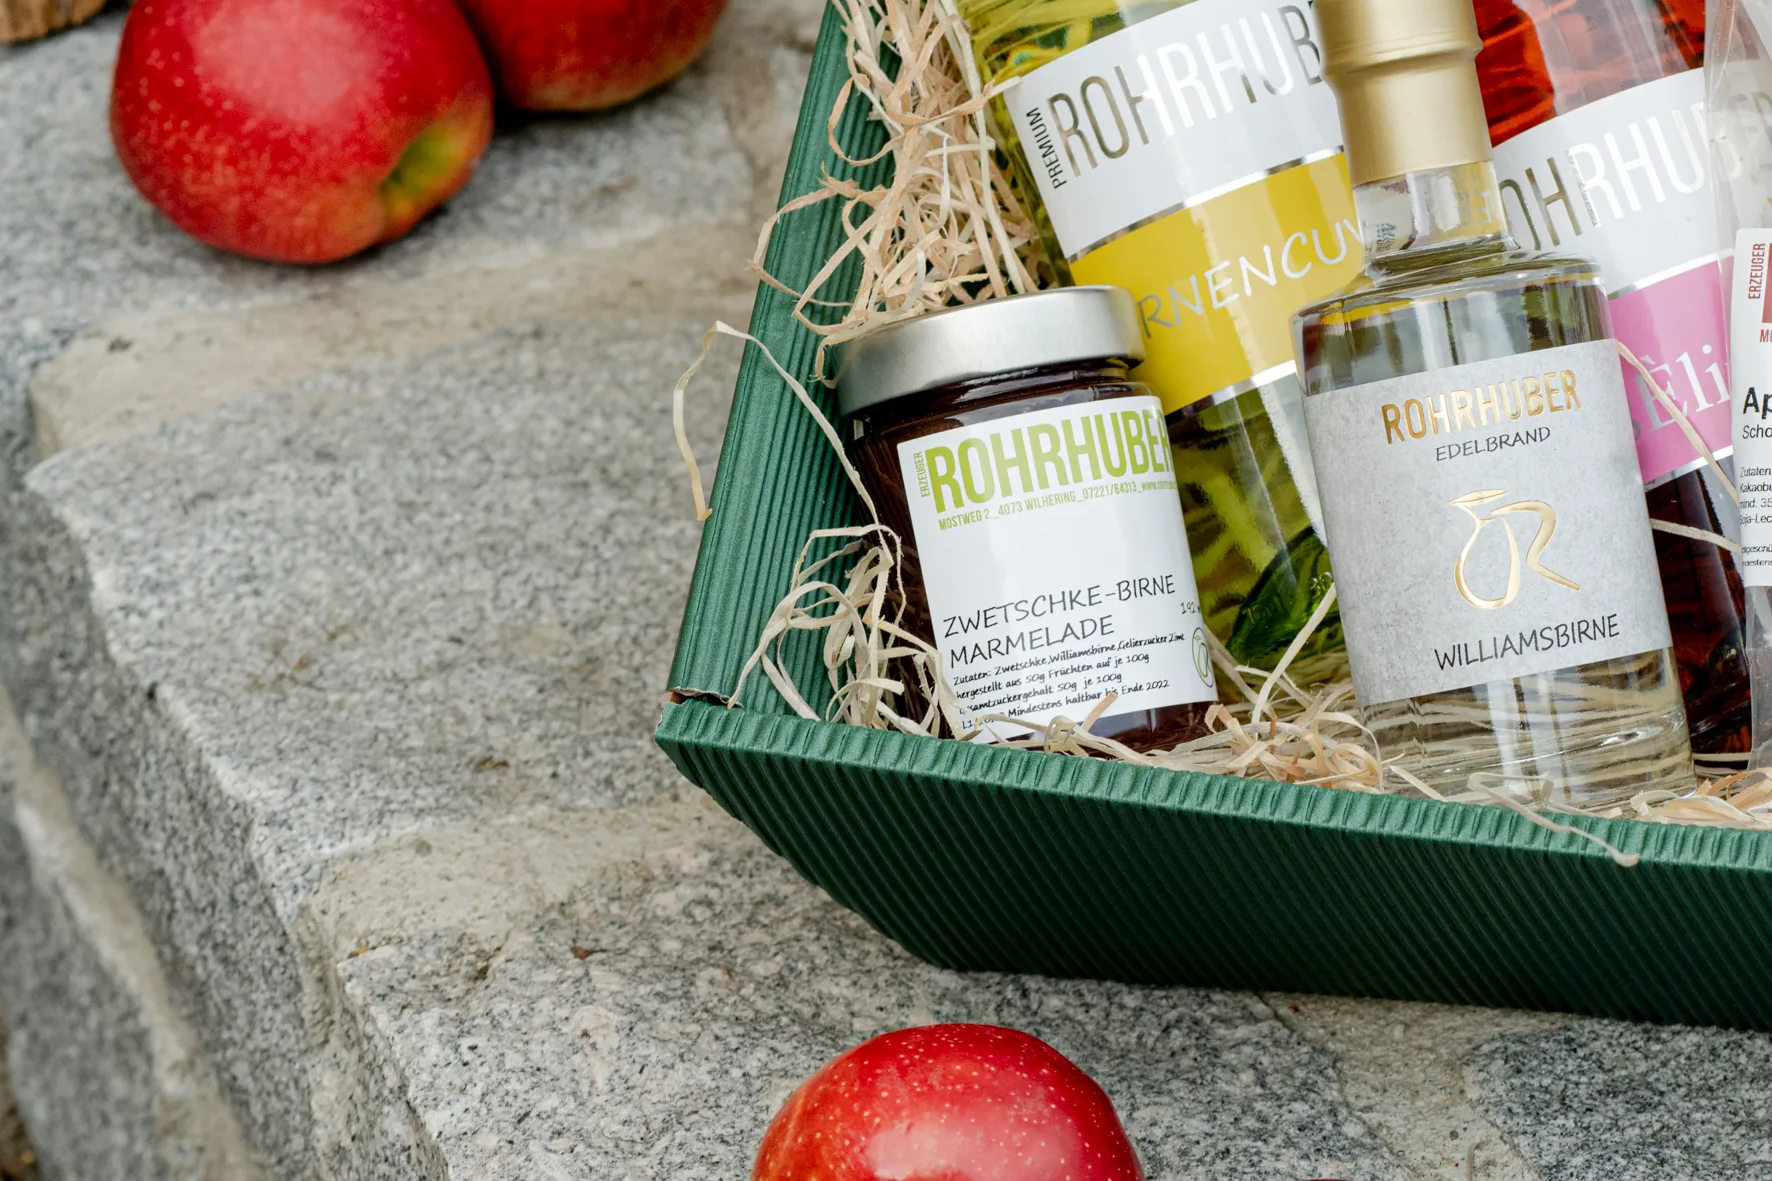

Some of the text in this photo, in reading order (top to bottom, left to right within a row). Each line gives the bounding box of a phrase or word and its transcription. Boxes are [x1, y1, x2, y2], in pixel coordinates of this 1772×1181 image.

[1046, 0, 1324, 178] ROHRHUB
[1026, 106, 1067, 190] PREMIUM
[1747, 243, 1766, 300] ERZEUGER
[1380, 370, 1582, 444] ROHRHUBER
[1436, 426, 1551, 461] EDELBRAND
[913, 451, 931, 498] ERZEUGER
[938, 510, 983, 531] MOSTWEG
[944, 574, 1175, 638] ZWETSCHKE-BIRNE
[949, 615, 1115, 668] MARMELADE
[1434, 613, 1620, 671] WILLIAMSBIRNE
[953, 671, 991, 686] Zutaten:
[956, 653, 1150, 699] hergestellt aus 50g Früchten auf je 100g
[1008, 699, 1062, 718] Mindestens
[1065, 691, 1102, 706] haltbar
[1121, 683, 1144, 695] Ende
[1146, 679, 1169, 691] 2022
[1057, 682, 1077, 692] 50g
[1083, 677, 1093, 689] je
[1096, 673, 1122, 683] 100g
